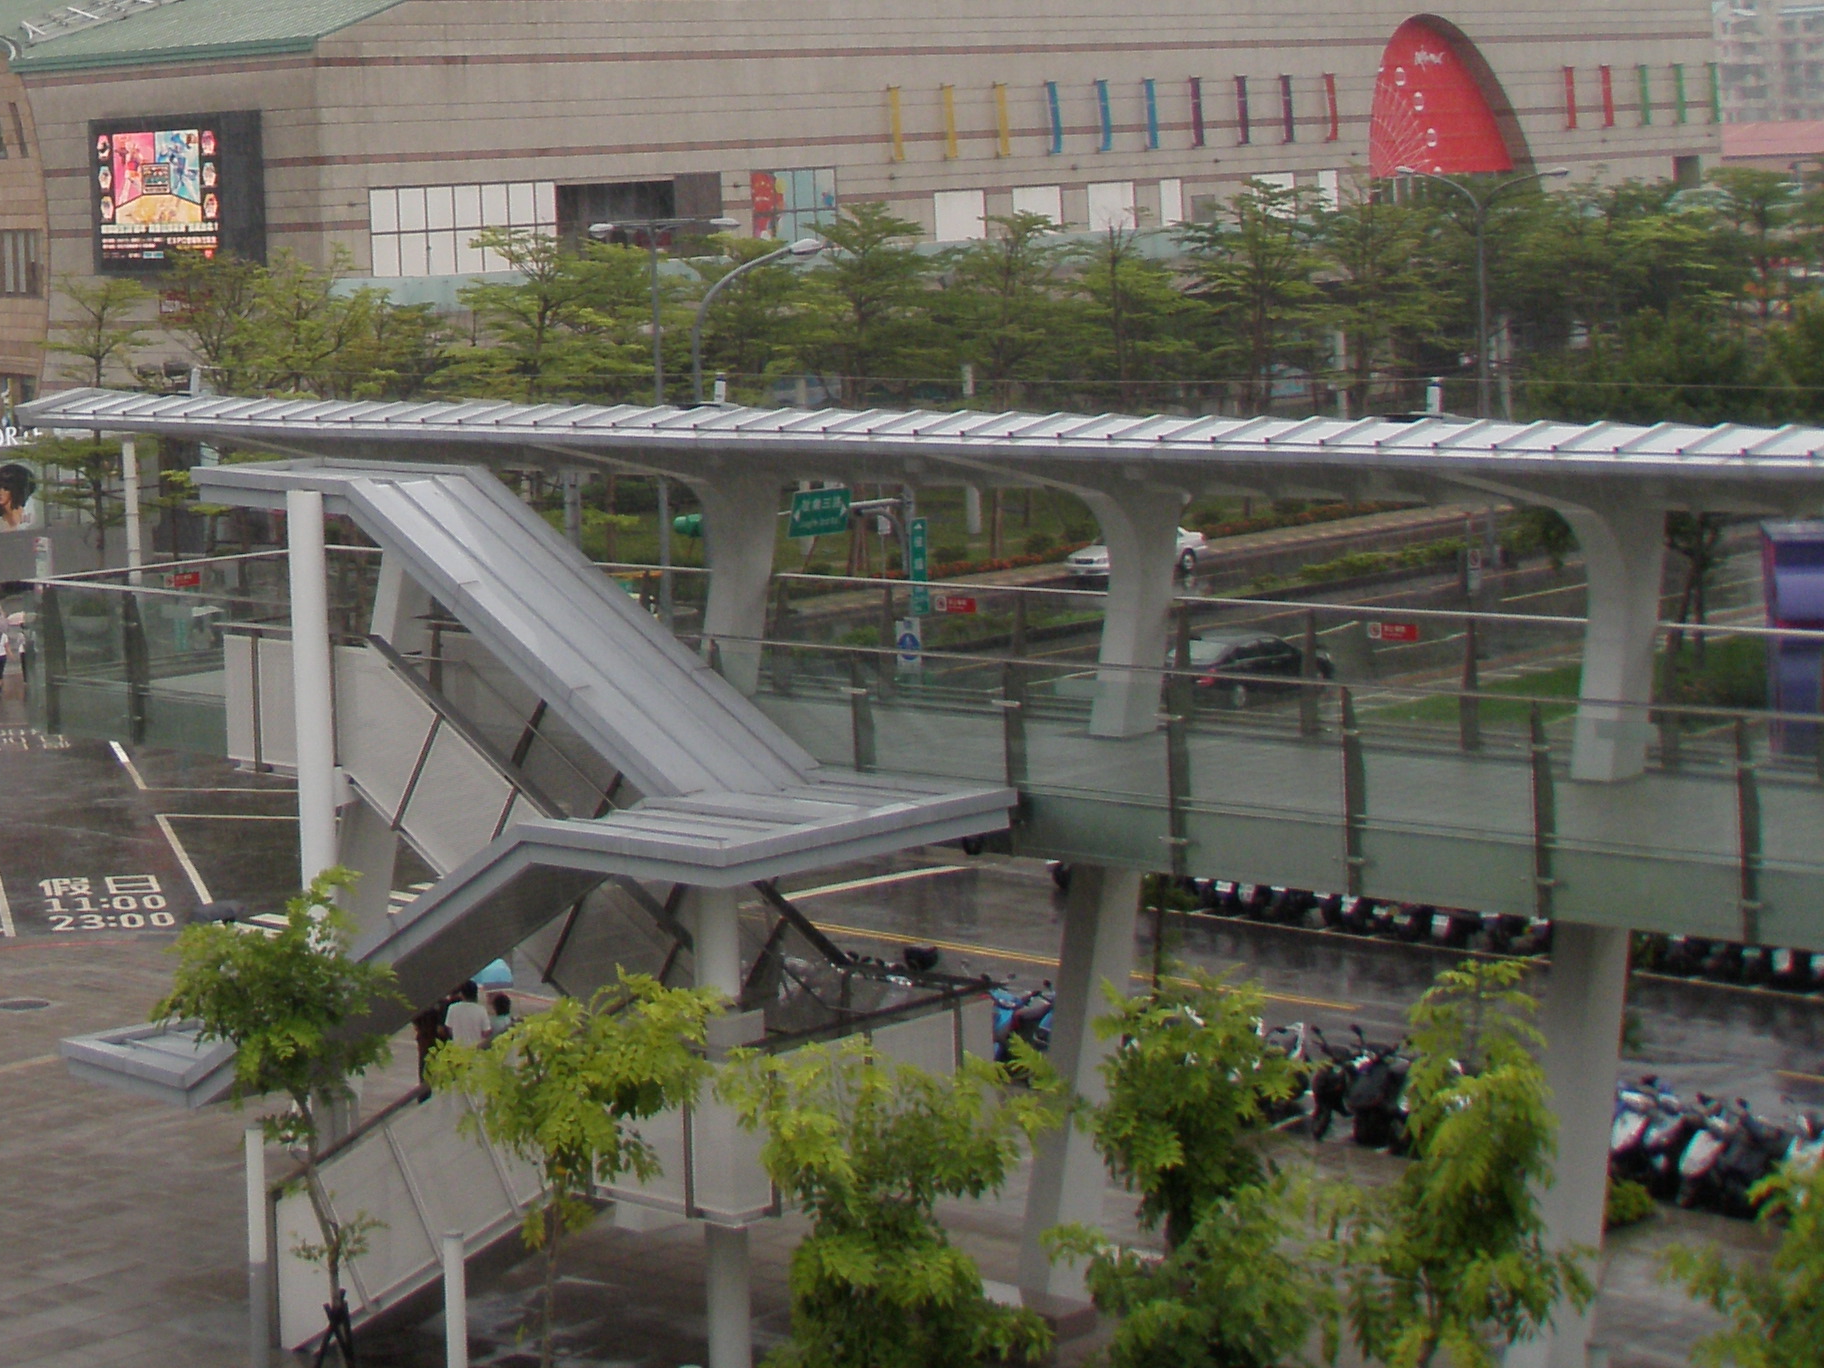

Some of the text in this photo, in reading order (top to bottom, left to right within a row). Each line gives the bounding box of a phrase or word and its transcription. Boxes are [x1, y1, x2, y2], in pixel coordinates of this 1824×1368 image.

[39, 875, 162, 896] 假日
[44, 894, 167, 912] 11:00
[49, 912, 175, 931] 23:00
